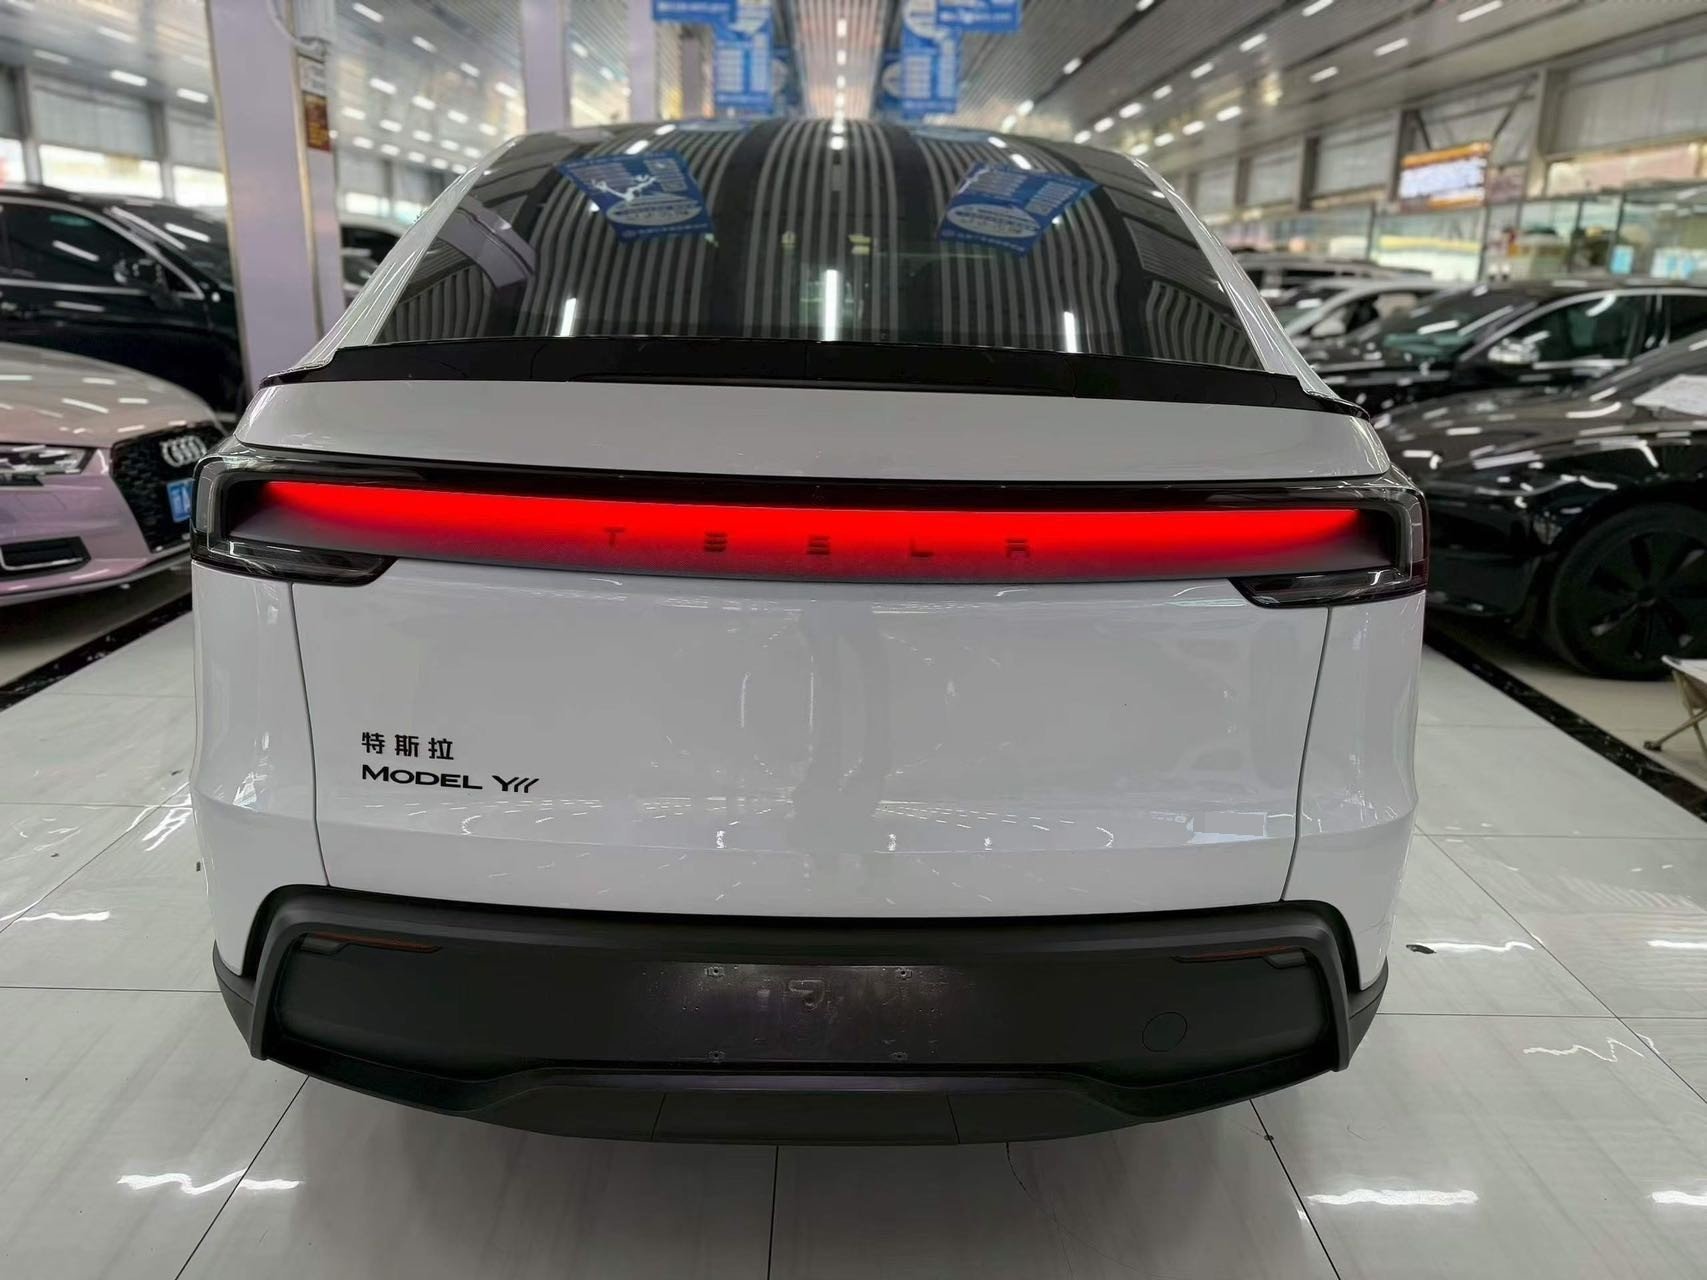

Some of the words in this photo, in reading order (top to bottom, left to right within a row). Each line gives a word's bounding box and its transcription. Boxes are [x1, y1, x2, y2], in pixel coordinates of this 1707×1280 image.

[603, 526, 1030, 558] TESLA
[361, 731, 454, 760] 特斯拉
[362, 764, 483, 790] MODEL
